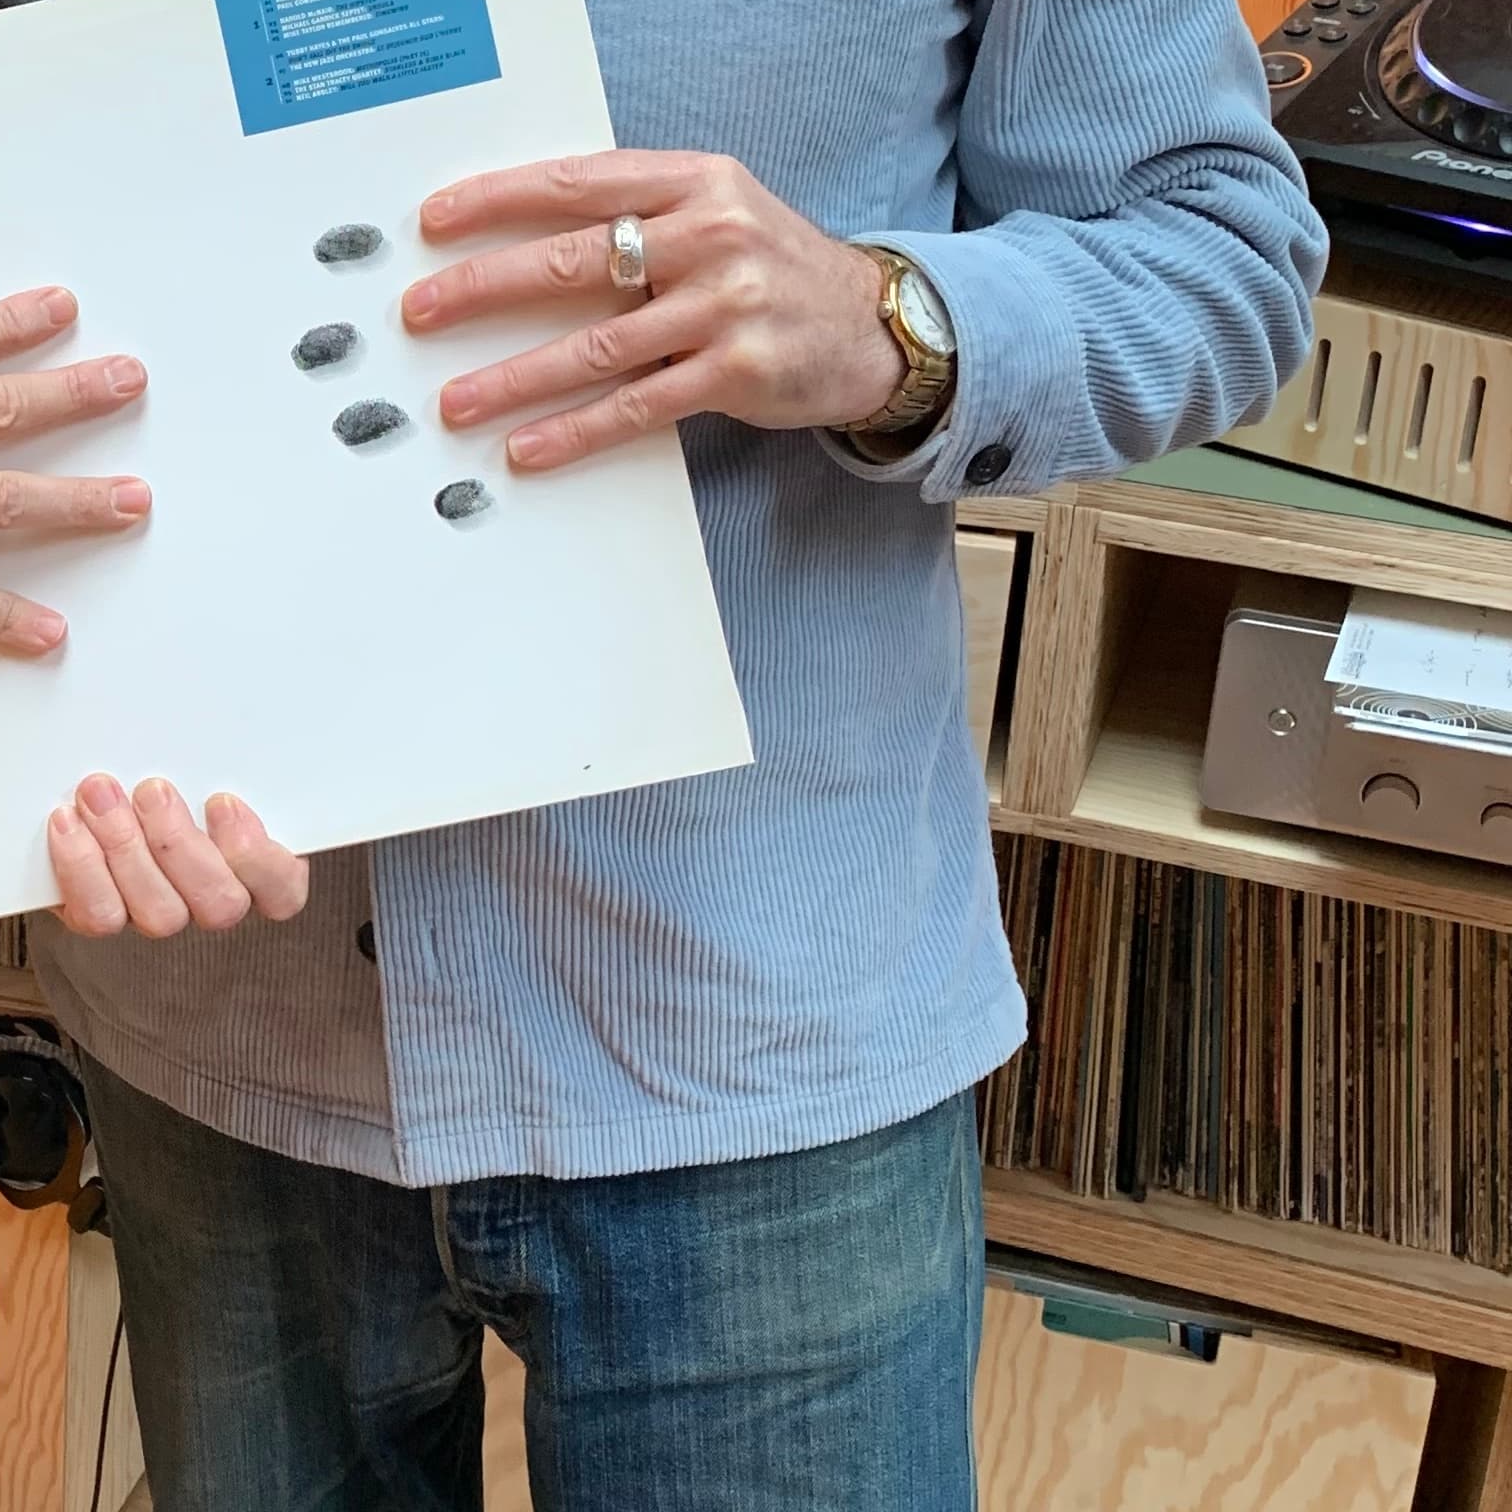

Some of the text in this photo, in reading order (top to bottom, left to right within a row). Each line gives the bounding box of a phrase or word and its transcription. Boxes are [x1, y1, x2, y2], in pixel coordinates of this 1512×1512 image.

[276, 0, 293, 10] PAUL
[337, 36, 350, 45] THE
[350, 32, 368, 42] PAUL
[288, 62, 302, 71] THE
[294, 85, 307, 94] THE
